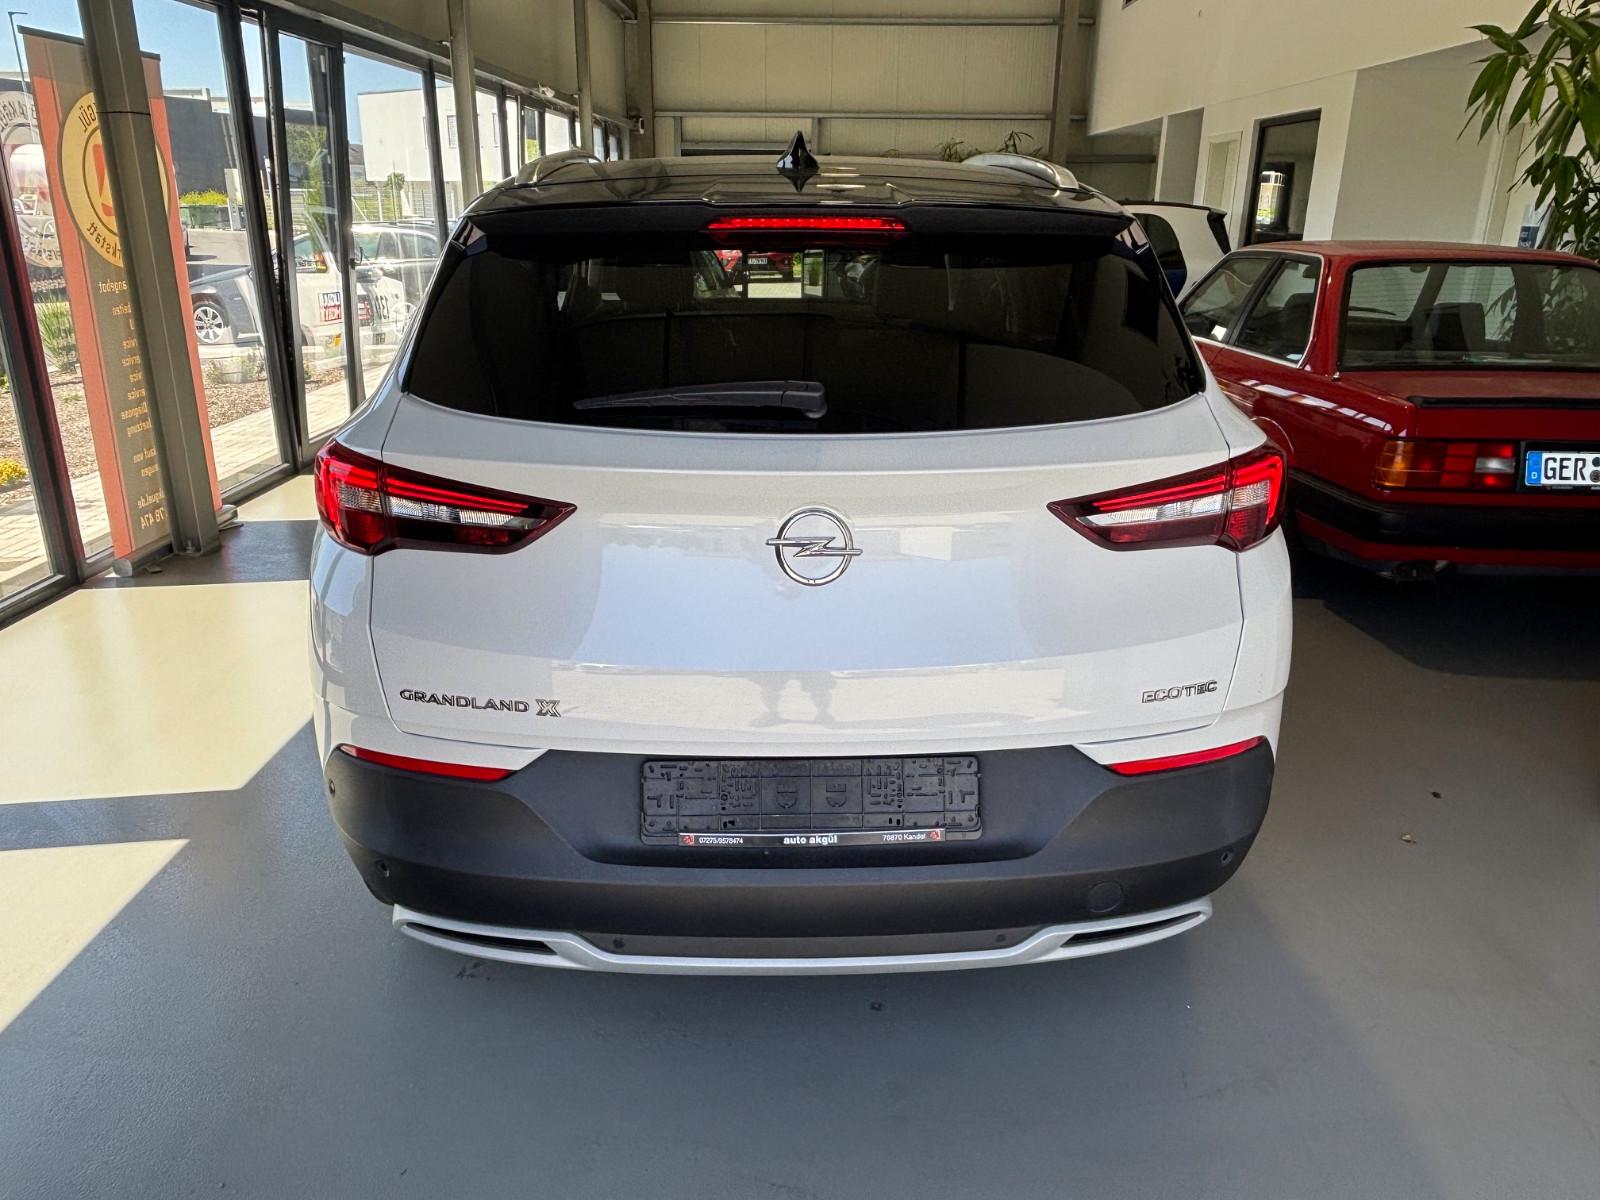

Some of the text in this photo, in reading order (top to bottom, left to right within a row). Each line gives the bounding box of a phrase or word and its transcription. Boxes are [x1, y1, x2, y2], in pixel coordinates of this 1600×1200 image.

[1543, 457, 1587, 481] GER
[1142, 680, 1218, 703] ECOTEC
[399, 689, 562, 718] GRANDLAND X
[783, 835, 807, 845] auto
[809, 834, 839, 846] akgül
